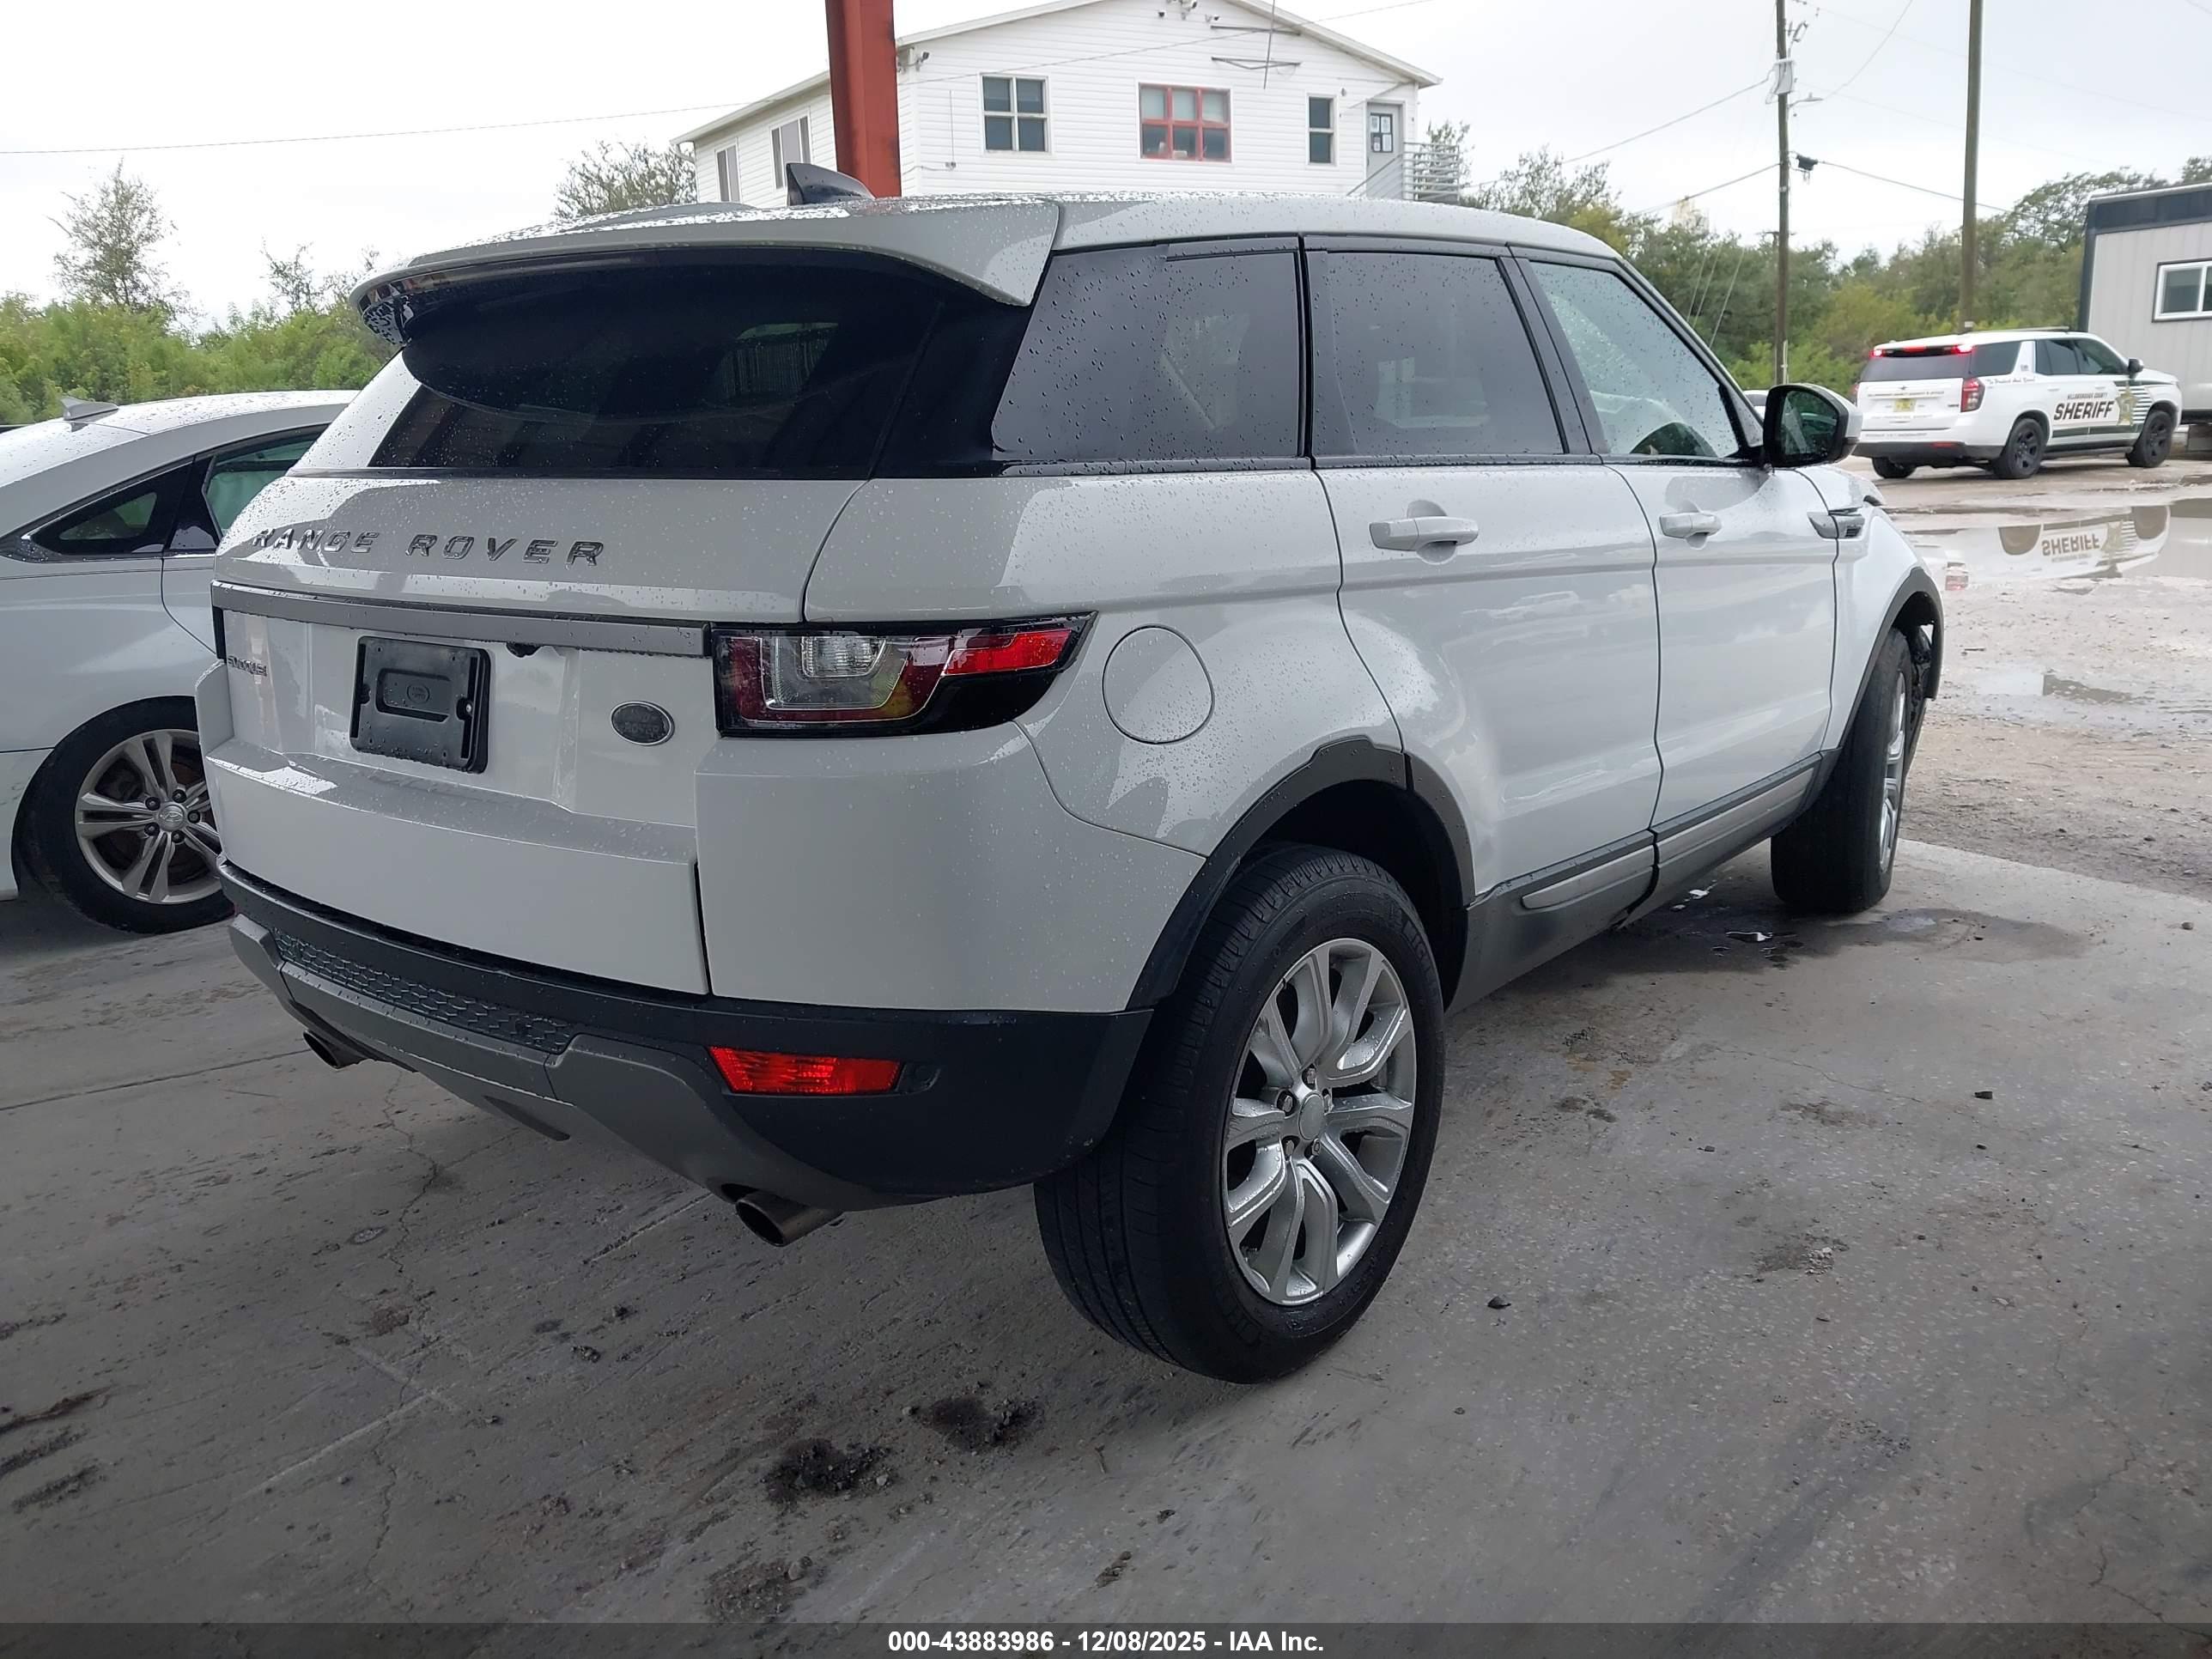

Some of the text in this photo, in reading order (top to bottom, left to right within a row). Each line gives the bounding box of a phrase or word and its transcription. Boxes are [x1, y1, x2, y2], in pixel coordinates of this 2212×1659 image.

[2053, 400, 2115, 421] SHERIFF
[252, 527, 605, 573] RANGE ROVER
